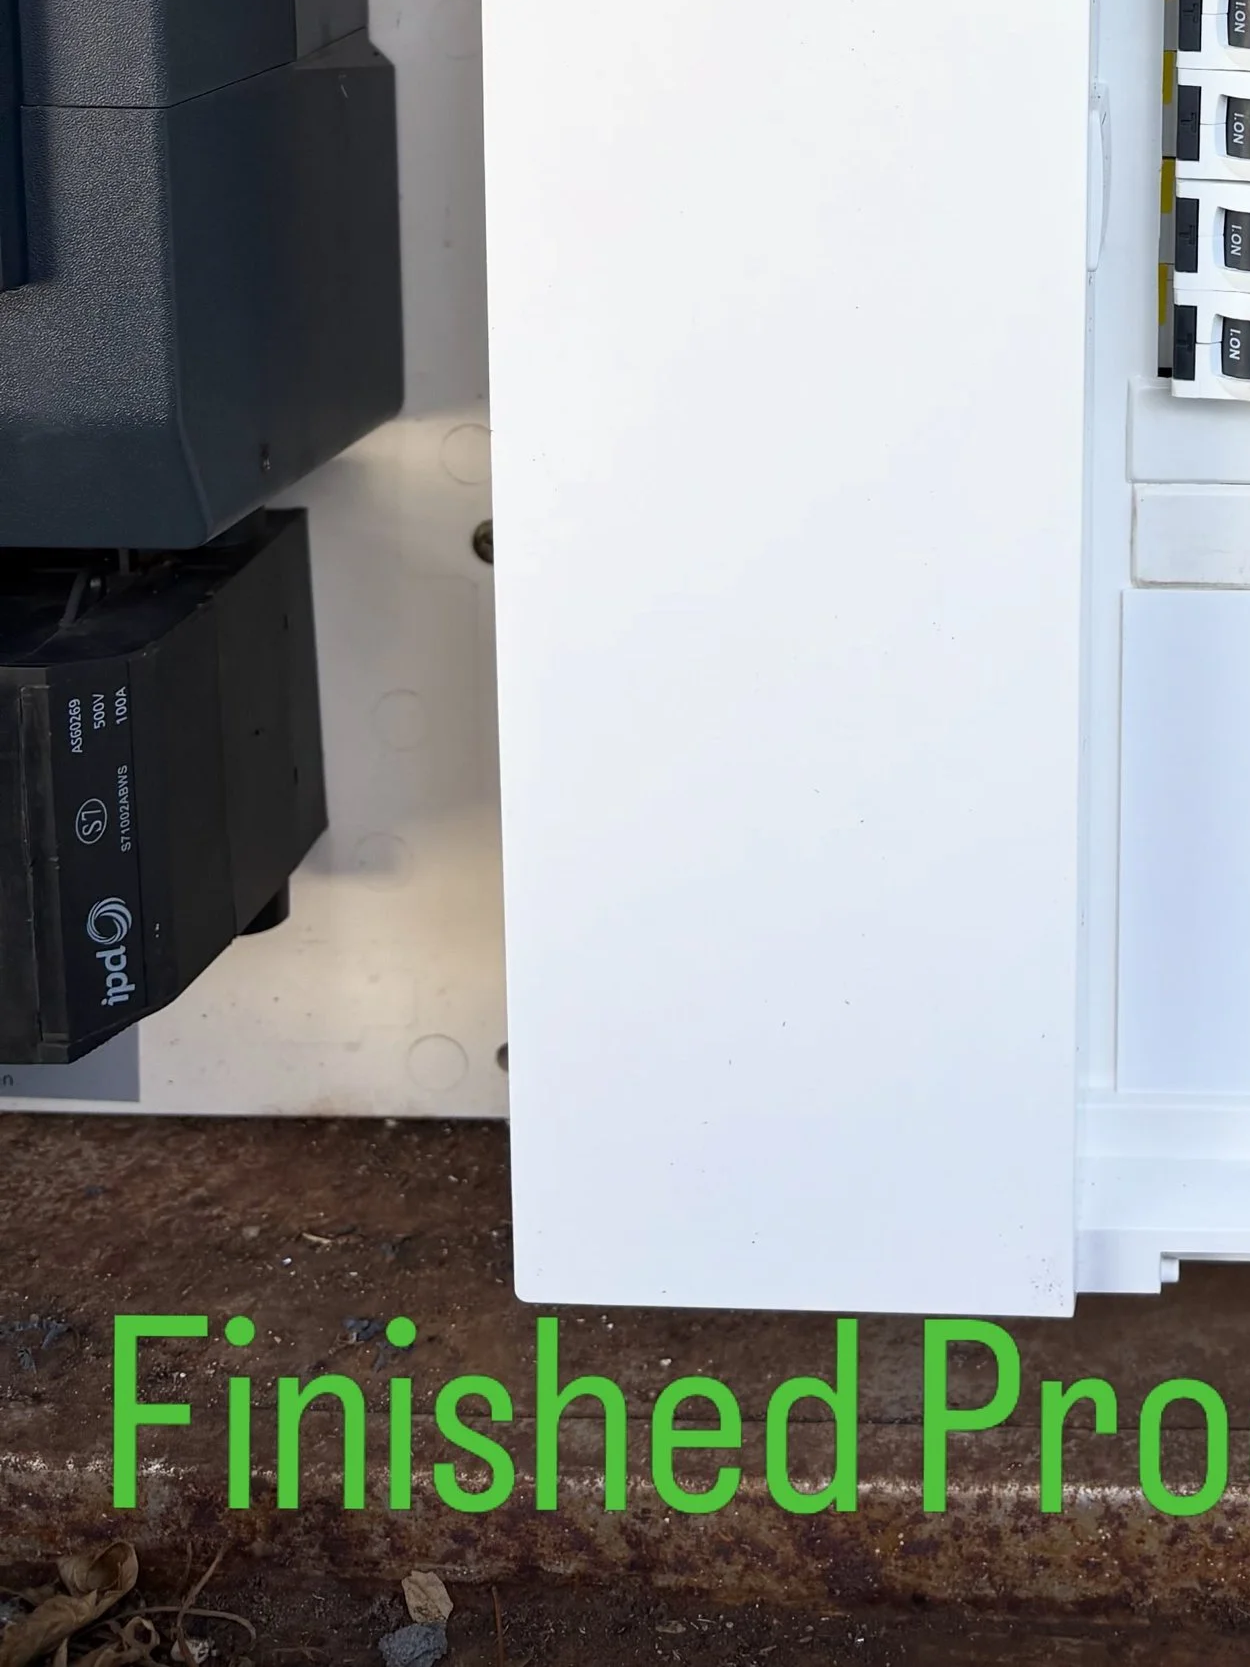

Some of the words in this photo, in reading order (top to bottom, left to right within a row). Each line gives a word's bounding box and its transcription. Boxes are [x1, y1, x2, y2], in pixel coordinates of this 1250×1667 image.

[69, 698, 83, 754] AS60269
[92, 693, 106, 729] 500V
[116, 686, 128, 725] 100A
[117, 765, 132, 851] S71002ABWS
[95, 945, 135, 1006] ipd
